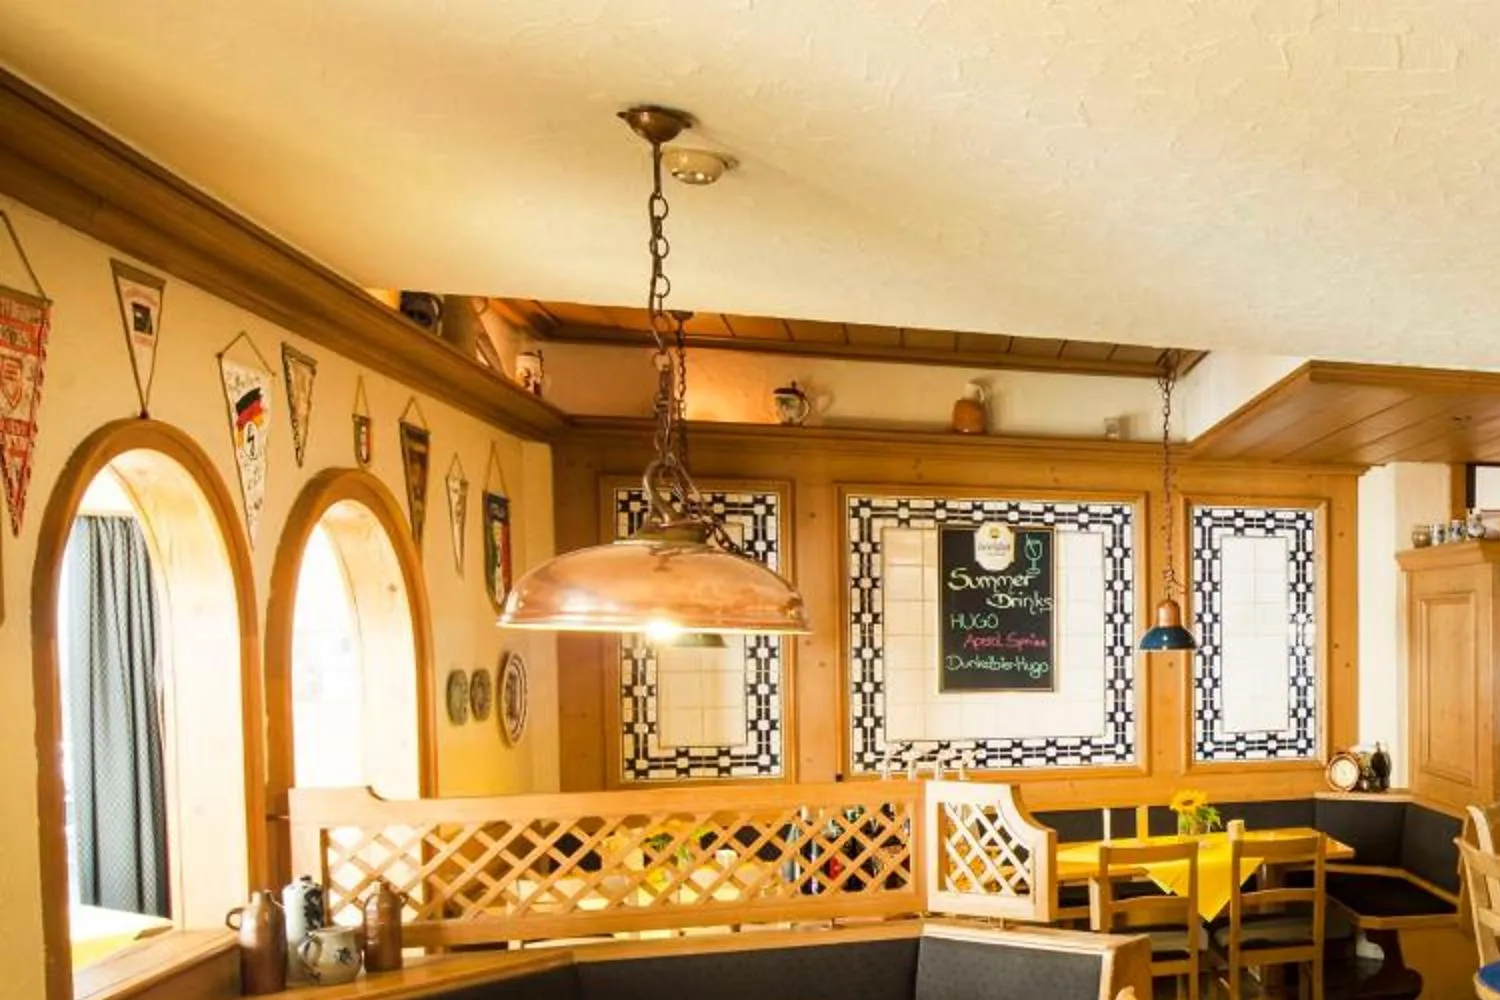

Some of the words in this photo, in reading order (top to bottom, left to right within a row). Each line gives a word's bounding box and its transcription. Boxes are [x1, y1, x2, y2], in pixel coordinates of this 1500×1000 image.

[947, 567, 1037, 594] Summer
[985, 590, 1053, 616] Drinks
[950, 613, 999, 630] HUGO
